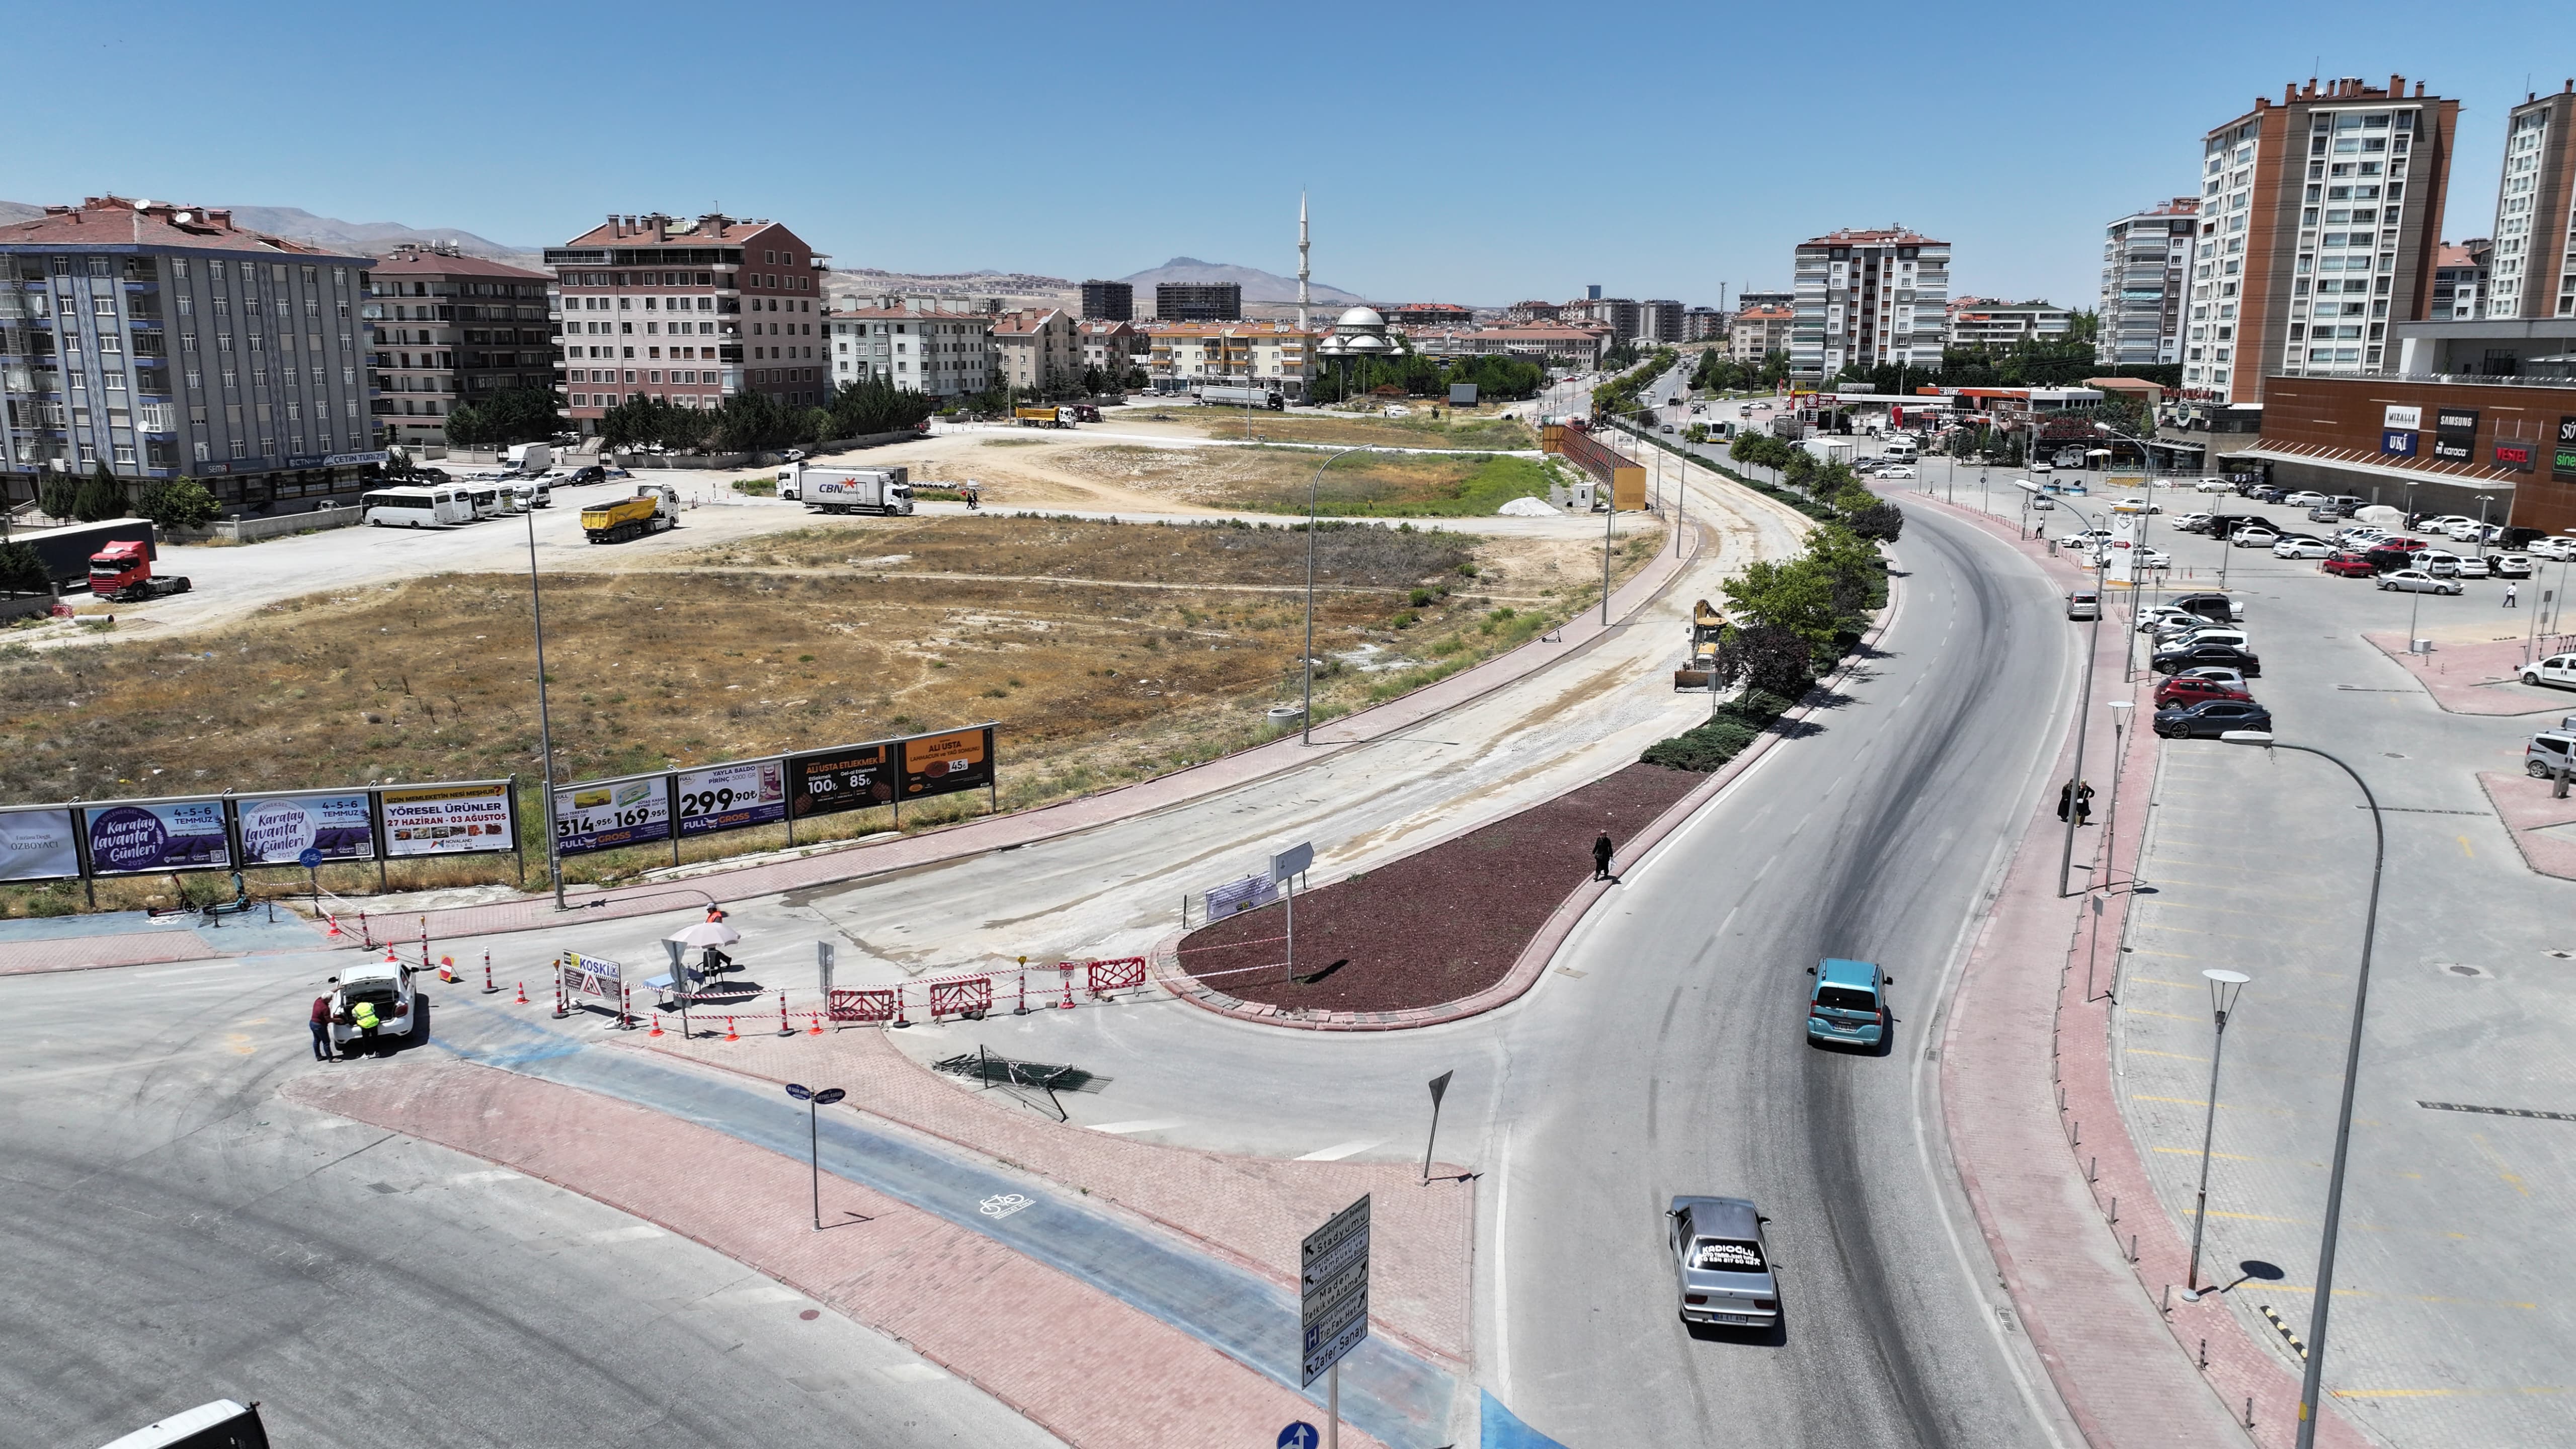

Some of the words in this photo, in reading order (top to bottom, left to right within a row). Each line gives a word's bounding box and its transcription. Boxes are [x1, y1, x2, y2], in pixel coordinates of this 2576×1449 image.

[2440, 416, 2472, 427] SAMSUNG
[334, 454, 357, 464] ÇETİN
[358, 452, 386, 461] TURİZM
[2444, 447, 2466, 457] karaca
[2496, 447, 2528, 462] VESTEL
[2556, 453, 2576, 466] sine
[208, 464, 227, 473] SEMA
[819, 484, 844, 494] CBN
[942, 741, 961, 750] USTA
[910, 753, 939, 762] LAHMACUN
[735, 765, 756, 773] BALDO
[819, 763, 838, 772] USTA
[708, 776, 730, 784] PİRİNÇ
[406, 791, 449, 802] MEMLEKETİN
[389, 806, 442, 816] YÖRESEL
[445, 802, 502, 813] ÜRÜNLER
[175, 817, 213, 825] TEMMUZ
[258, 811, 304, 827] Karatay
[402, 817, 443, 826] HAZİRAN
[465, 813, 506, 823] AĞUSTOS
[684, 820, 706, 830] FULL
[719, 812, 750, 824] GROSS
[107, 818, 155, 834] Karatay
[245, 823, 297, 843] Lavanta
[93, 830, 148, 850] Lavanta
[261, 835, 304, 854] Günleri
[559, 839, 584, 849] FULL
[598, 831, 631, 843] GROSS
[110, 842, 155, 862] Günleri
[580, 958, 609, 976] KOSKİ
[1314, 1231, 1326, 1244] Konya
[1318, 1214, 1365, 1253] Stadyumu
[1355, 1240, 1362, 1248] ve
[1703, 1245, 1754, 1257] KADIOĞLU
[1315, 1268, 1332, 1286] Teknoloji
[1320, 1273, 1349, 1301] Maden
[1305, 1301, 1326, 1322] Tetkik
[1327, 1295, 1335, 1305] ve
[1336, 1277, 1357, 1299] Arama
[1345, 1306, 1357, 1319] Hst.
[1315, 1345, 1337, 1372] Zafer
[1339, 1319, 1366, 1350] Sanayi
